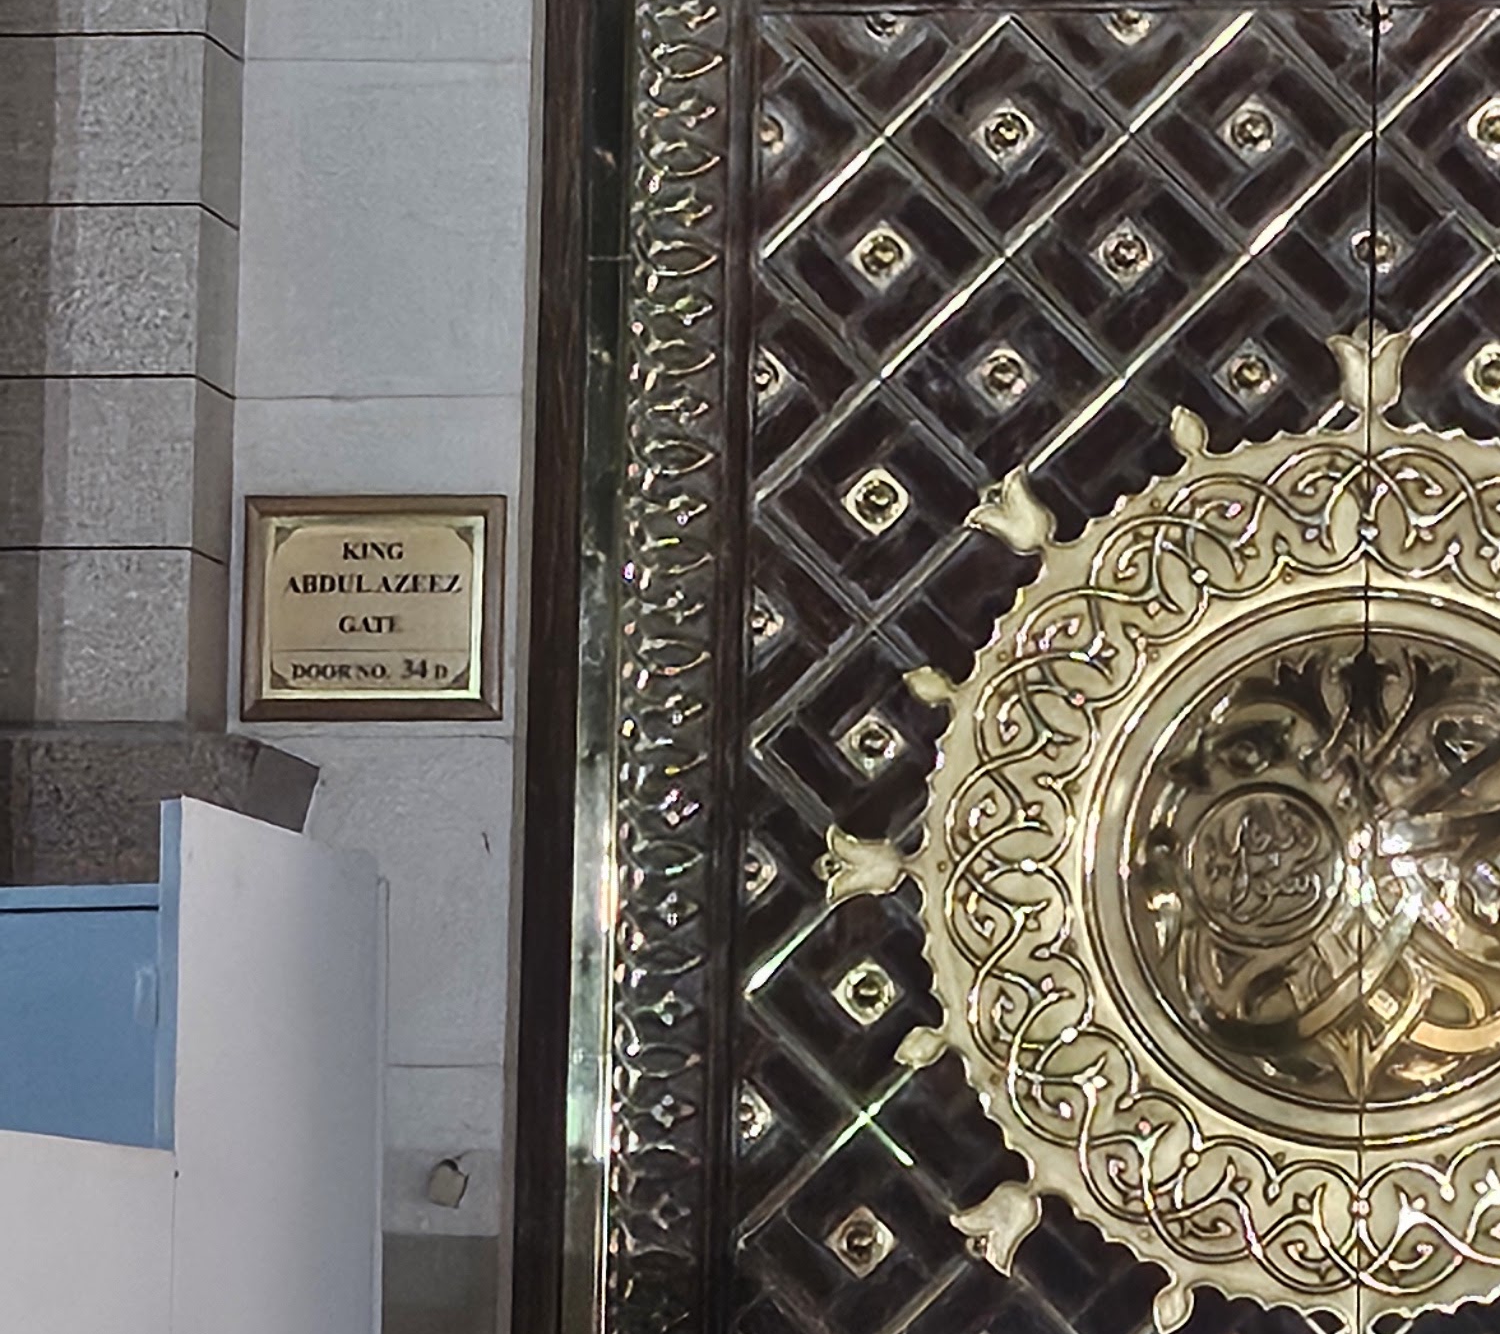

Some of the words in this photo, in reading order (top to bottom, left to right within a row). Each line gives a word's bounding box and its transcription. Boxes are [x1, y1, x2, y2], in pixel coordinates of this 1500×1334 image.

[342, 541, 404, 560] KING
[285, 573, 463, 594] ABDULAZEEZ
[338, 615, 402, 634] GATE
[291, 663, 351, 681] DOOR
[401, 658, 427, 679] 34
[434, 663, 449, 680] D
